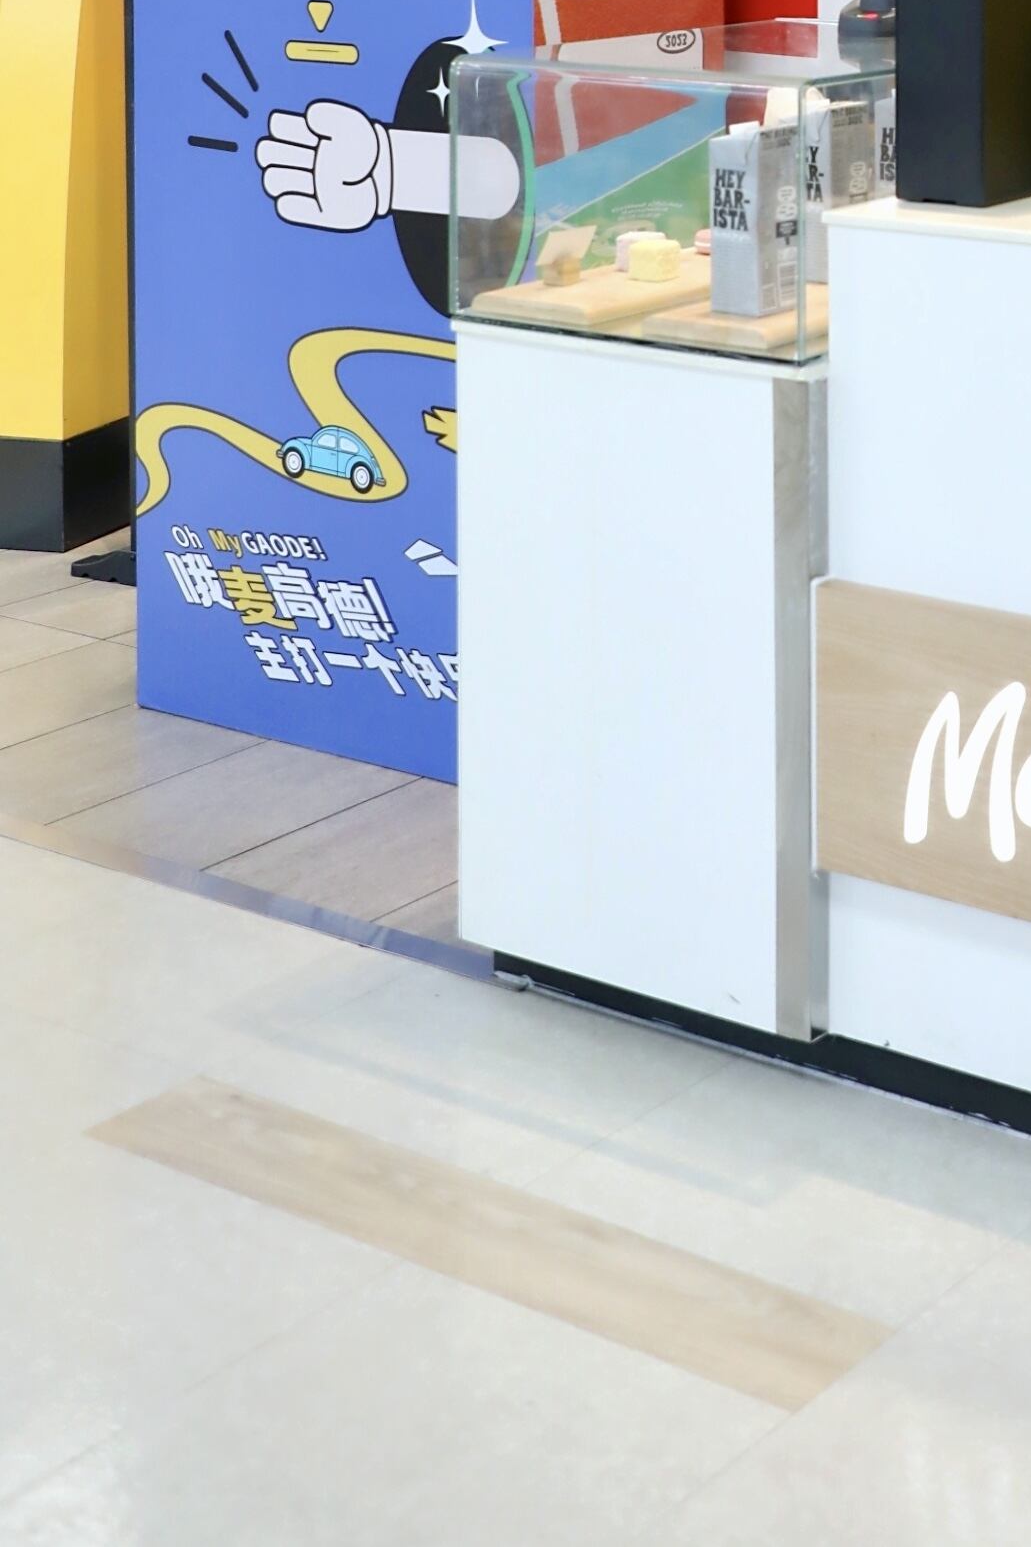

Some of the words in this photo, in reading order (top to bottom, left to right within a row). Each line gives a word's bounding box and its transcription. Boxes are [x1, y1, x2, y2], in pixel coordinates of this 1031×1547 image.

[715, 169, 745, 189] HEY
[714, 188, 750, 209] BAR-
[713, 208, 748, 231] ISTA
[171, 525, 203, 549] Oh
[207, 528, 243, 558] My
[241, 532, 327, 561] GAODE!
